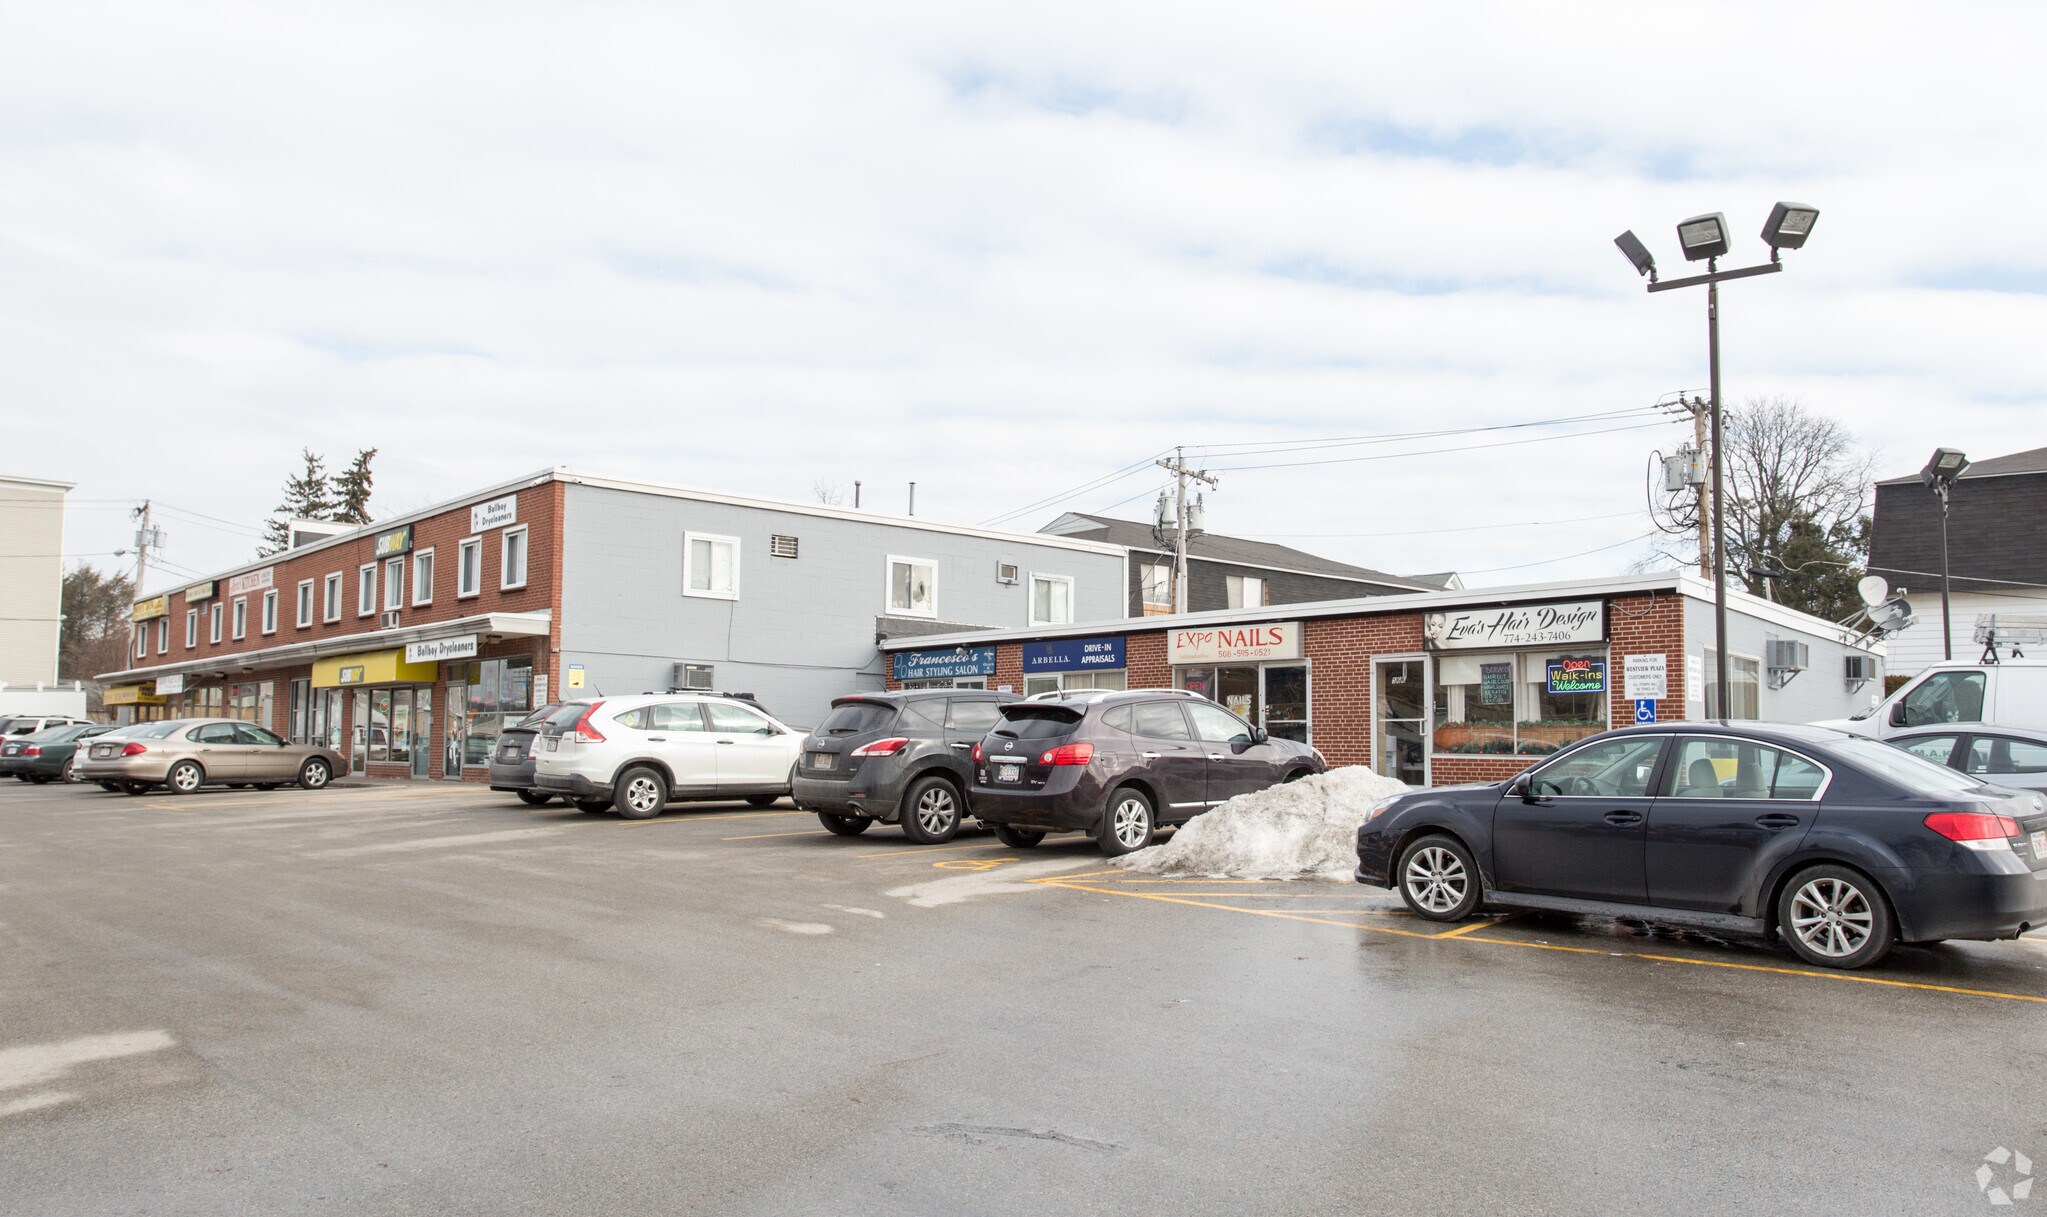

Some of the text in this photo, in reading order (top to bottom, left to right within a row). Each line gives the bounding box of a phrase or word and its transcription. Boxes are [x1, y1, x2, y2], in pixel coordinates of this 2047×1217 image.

[482, 512, 512, 526] Drycleaners
[376, 530, 407, 556] SUBWAY
[1445, 606, 1598, 642] Eva's Hair Design
[1218, 627, 1283, 648] NAILS
[1503, 630, 1571, 643] 774-243-7406
[439, 640, 474, 656] Drycleaners
[1084, 643, 1112, 653] DRIVE-IN
[908, 649, 978, 667] Francesco's
[1081, 654, 1115, 664] APPRAISALS
[908, 664, 978, 678] HAIR STYLING SALON
[1562, 659, 1591, 671] Open
[340, 666, 363, 683] SUBWAY
[1550, 670, 1603, 680] Walk-ins
[1185, 681, 1205, 690] OPEN
[1552, 680, 1601, 690] Welcome
[1226, 694, 1252, 705] NAILS
